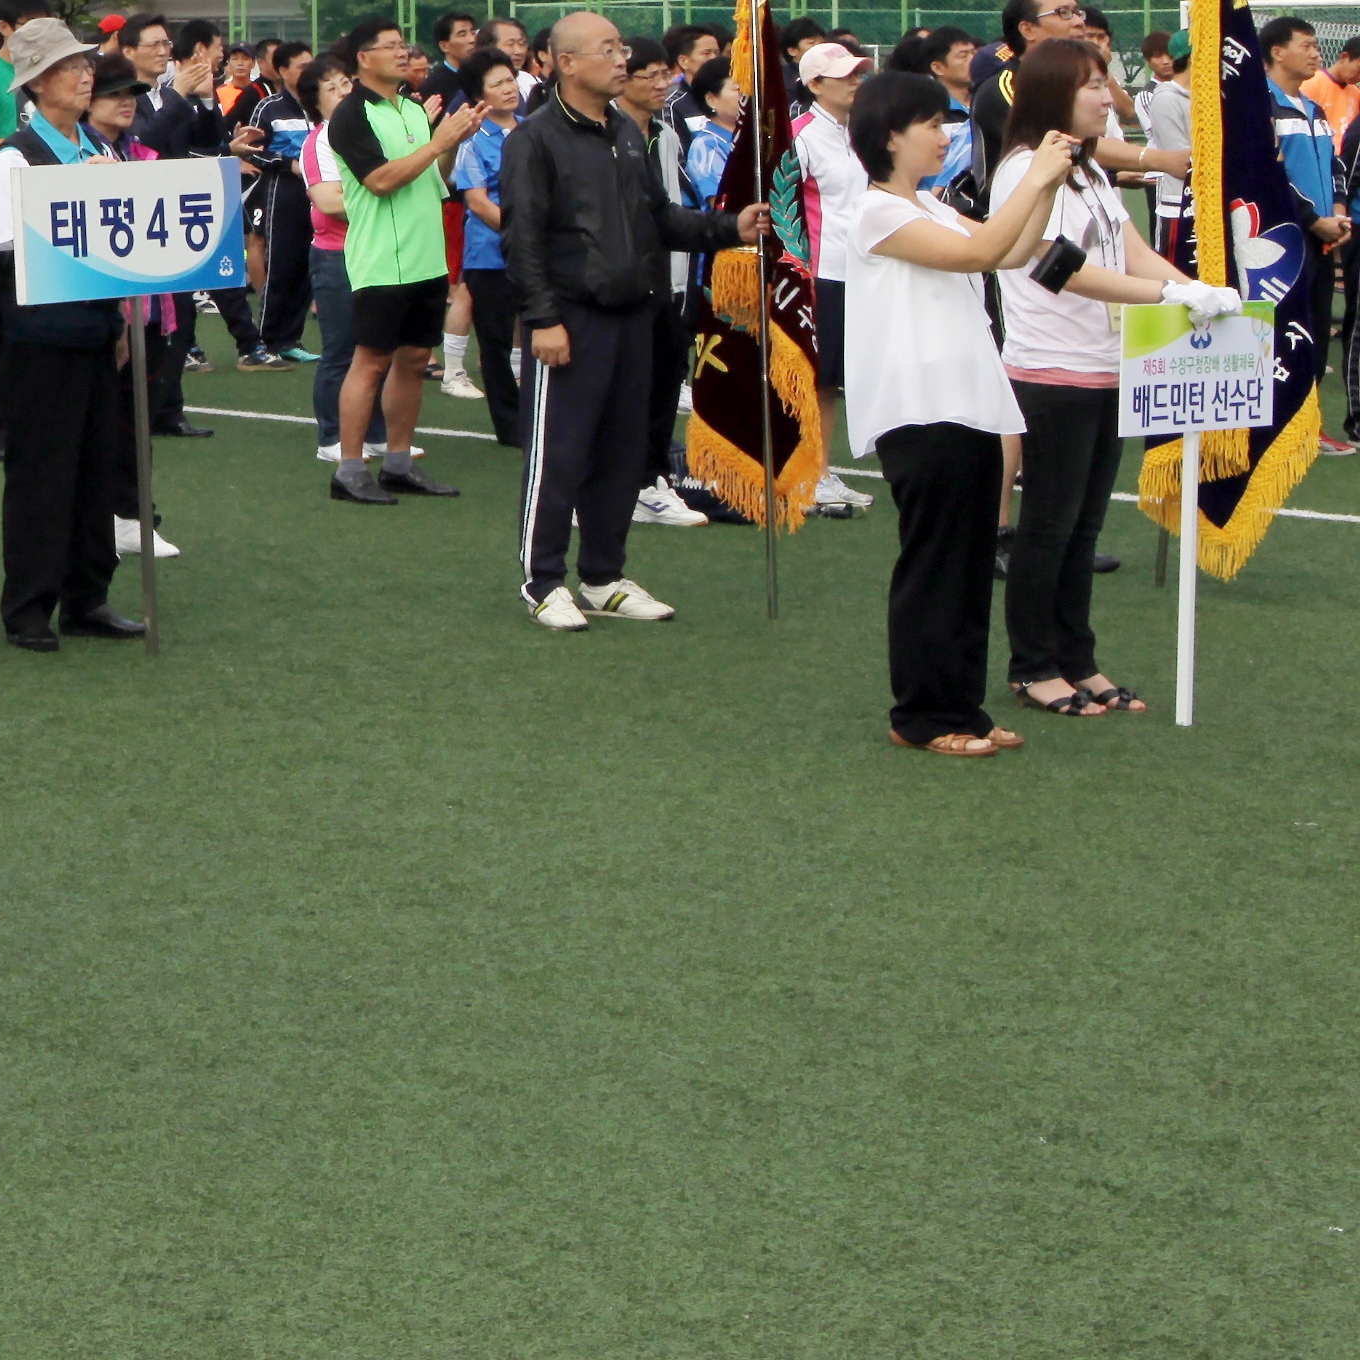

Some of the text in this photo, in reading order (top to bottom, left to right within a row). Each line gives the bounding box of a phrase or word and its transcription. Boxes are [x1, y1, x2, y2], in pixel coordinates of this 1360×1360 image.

[49, 192, 214, 259] 태평4동
[1142, 352, 1256, 376] 제5회 수정구청장배 생활체육
[1132, 378, 1264, 428] 배드민턴 선수단
